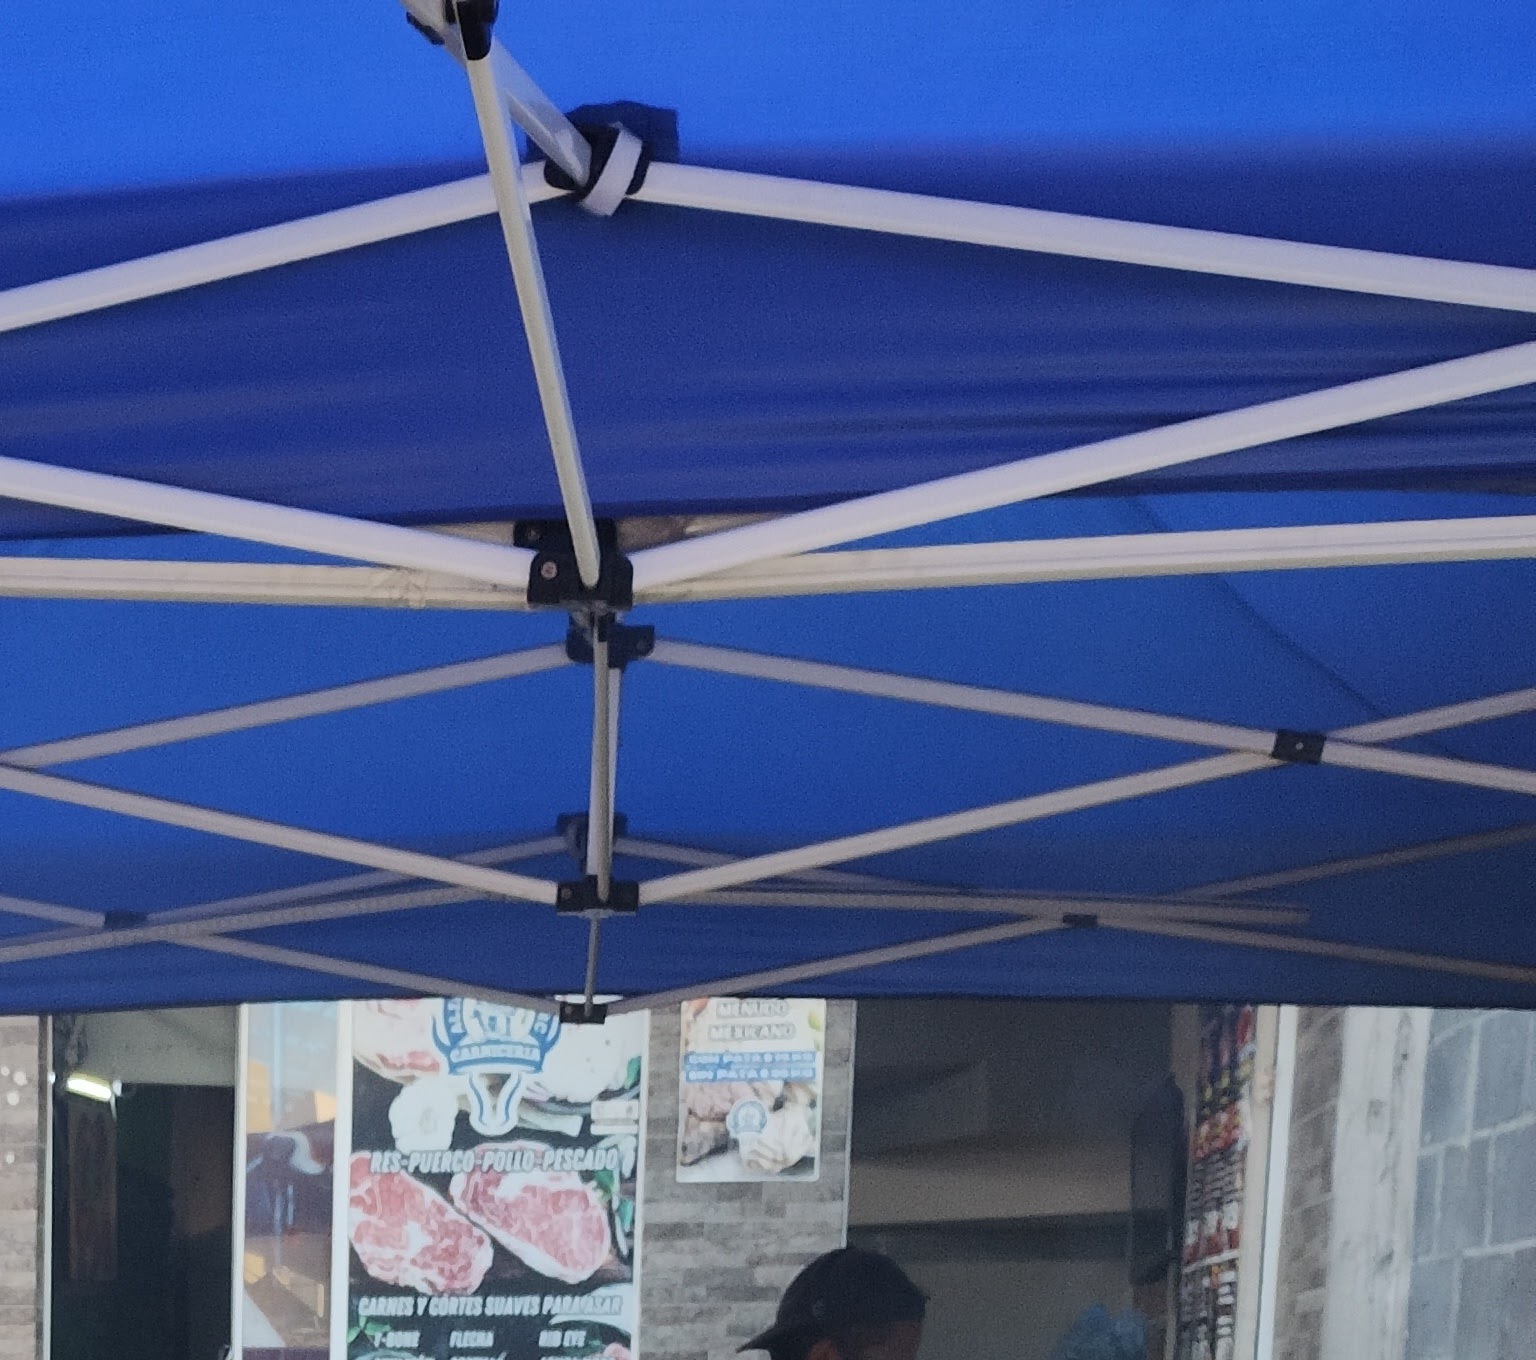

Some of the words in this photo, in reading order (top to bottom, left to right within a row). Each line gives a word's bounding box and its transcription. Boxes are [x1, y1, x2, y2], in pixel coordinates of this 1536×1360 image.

[358, 1295, 415, 1316] CARNES
[416, 1296, 427, 1316] Y
[484, 1295, 541, 1316] SUAVES
